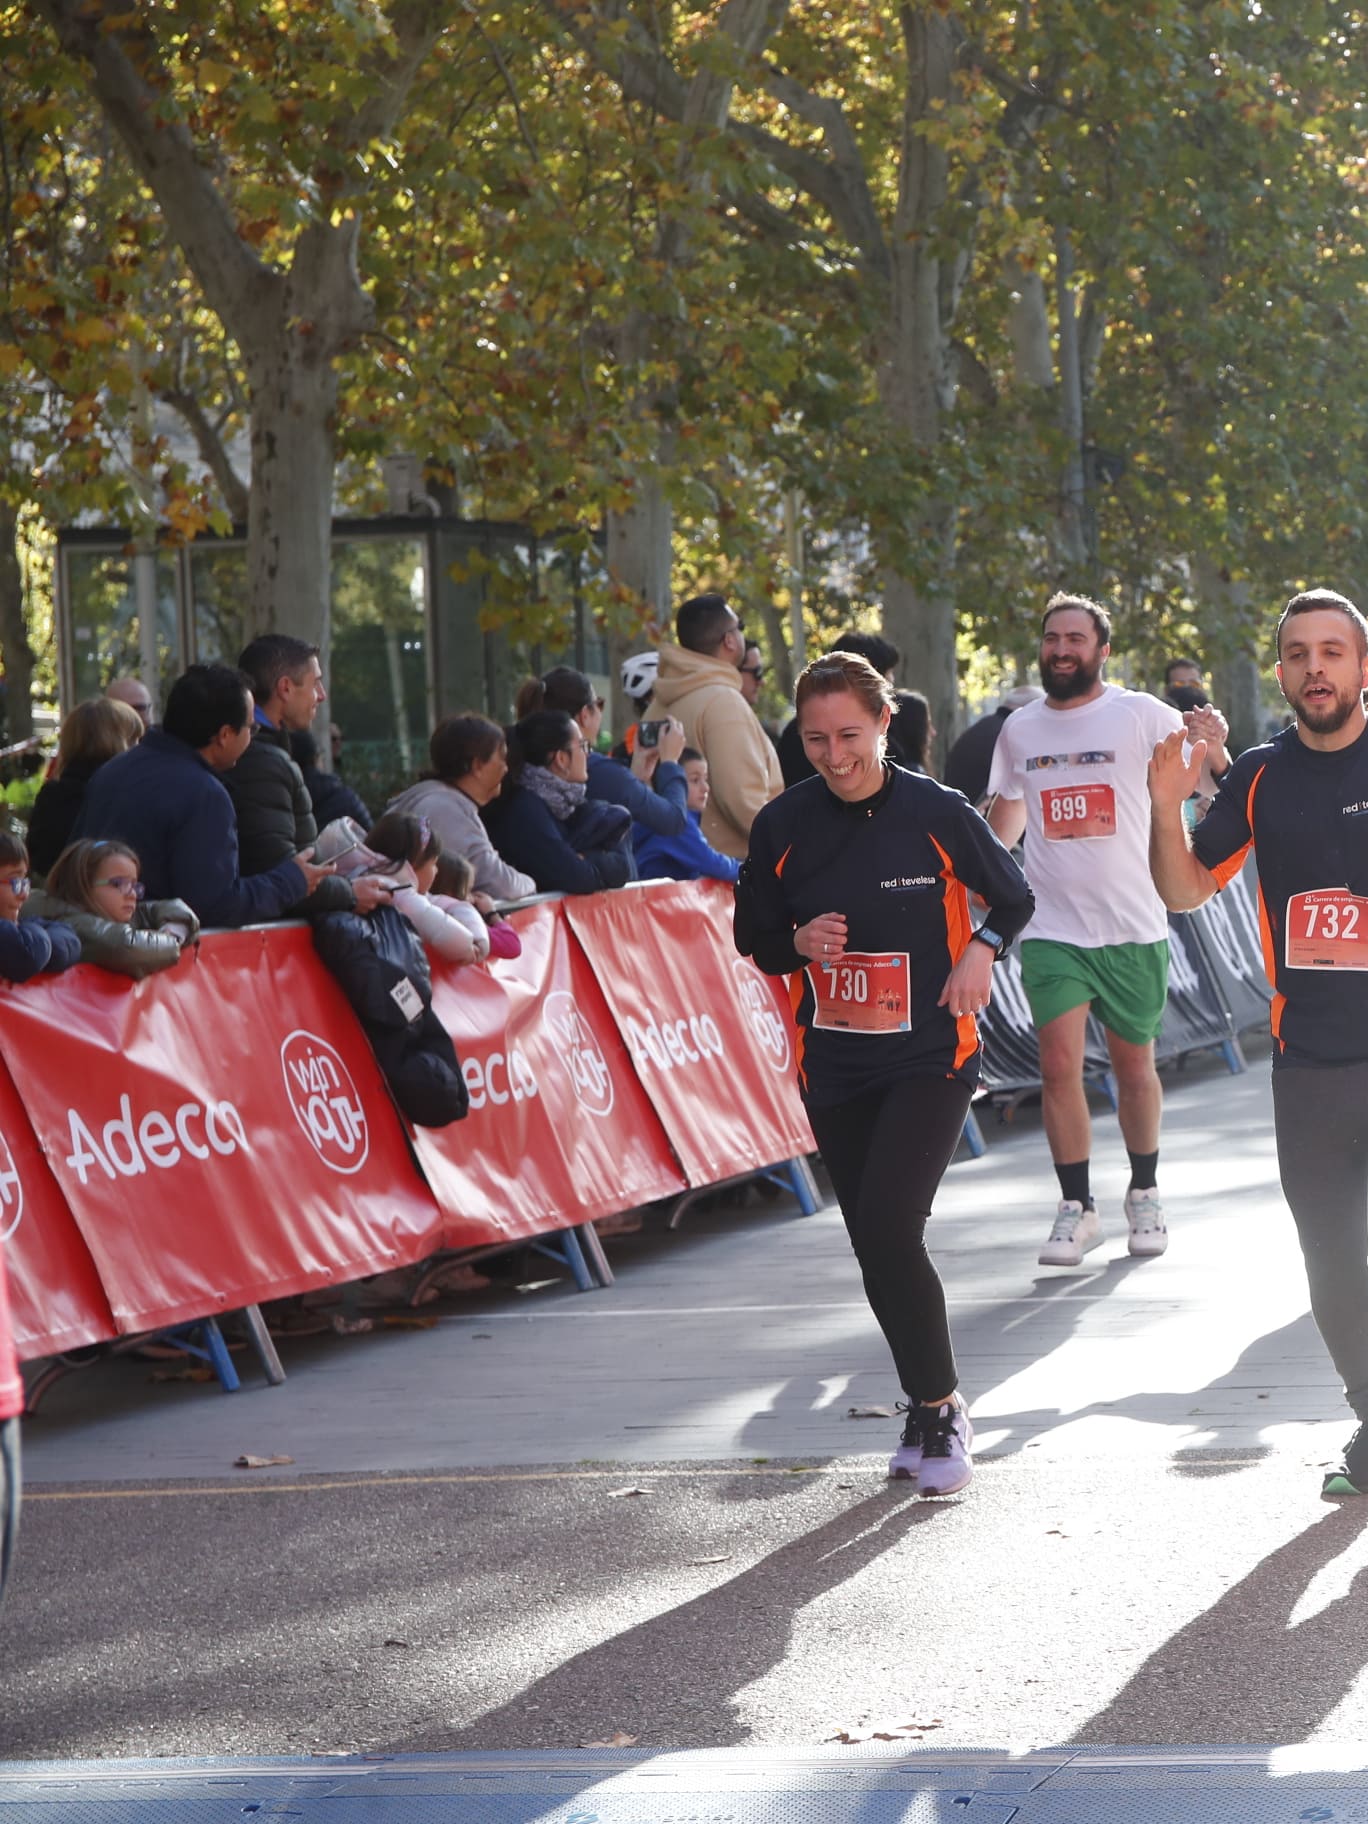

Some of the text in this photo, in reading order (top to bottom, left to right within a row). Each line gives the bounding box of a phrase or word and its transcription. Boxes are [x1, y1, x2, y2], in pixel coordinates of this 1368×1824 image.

[1051, 794, 1087, 822] 899
[1342, 803, 1359, 815] red
[880, 878, 897, 889] red
[1303, 904, 1360, 939] 732
[822, 967, 868, 1003] 730
[626, 1007, 723, 1074] Adecco
[460, 1050, 539, 1109] ecco
[66, 1092, 250, 1185] Adecco
